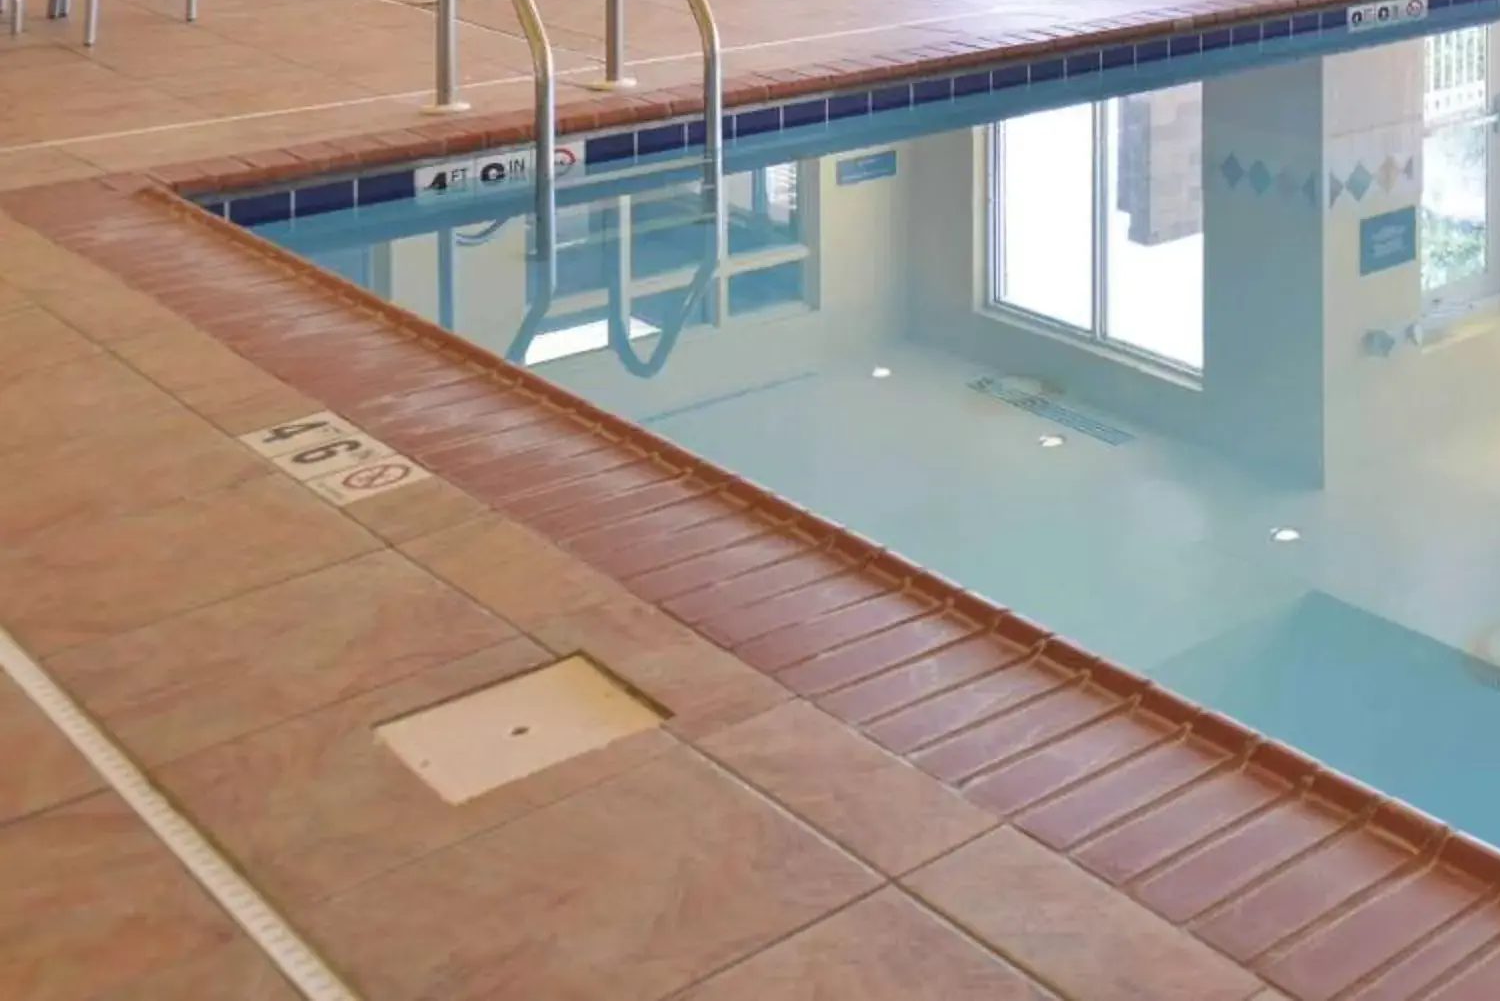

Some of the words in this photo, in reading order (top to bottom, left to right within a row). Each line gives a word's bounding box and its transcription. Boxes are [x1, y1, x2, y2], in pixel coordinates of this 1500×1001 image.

[508, 159, 525, 179] IN
[262, 421, 330, 444] 4
[291, 439, 362, 464] 6
